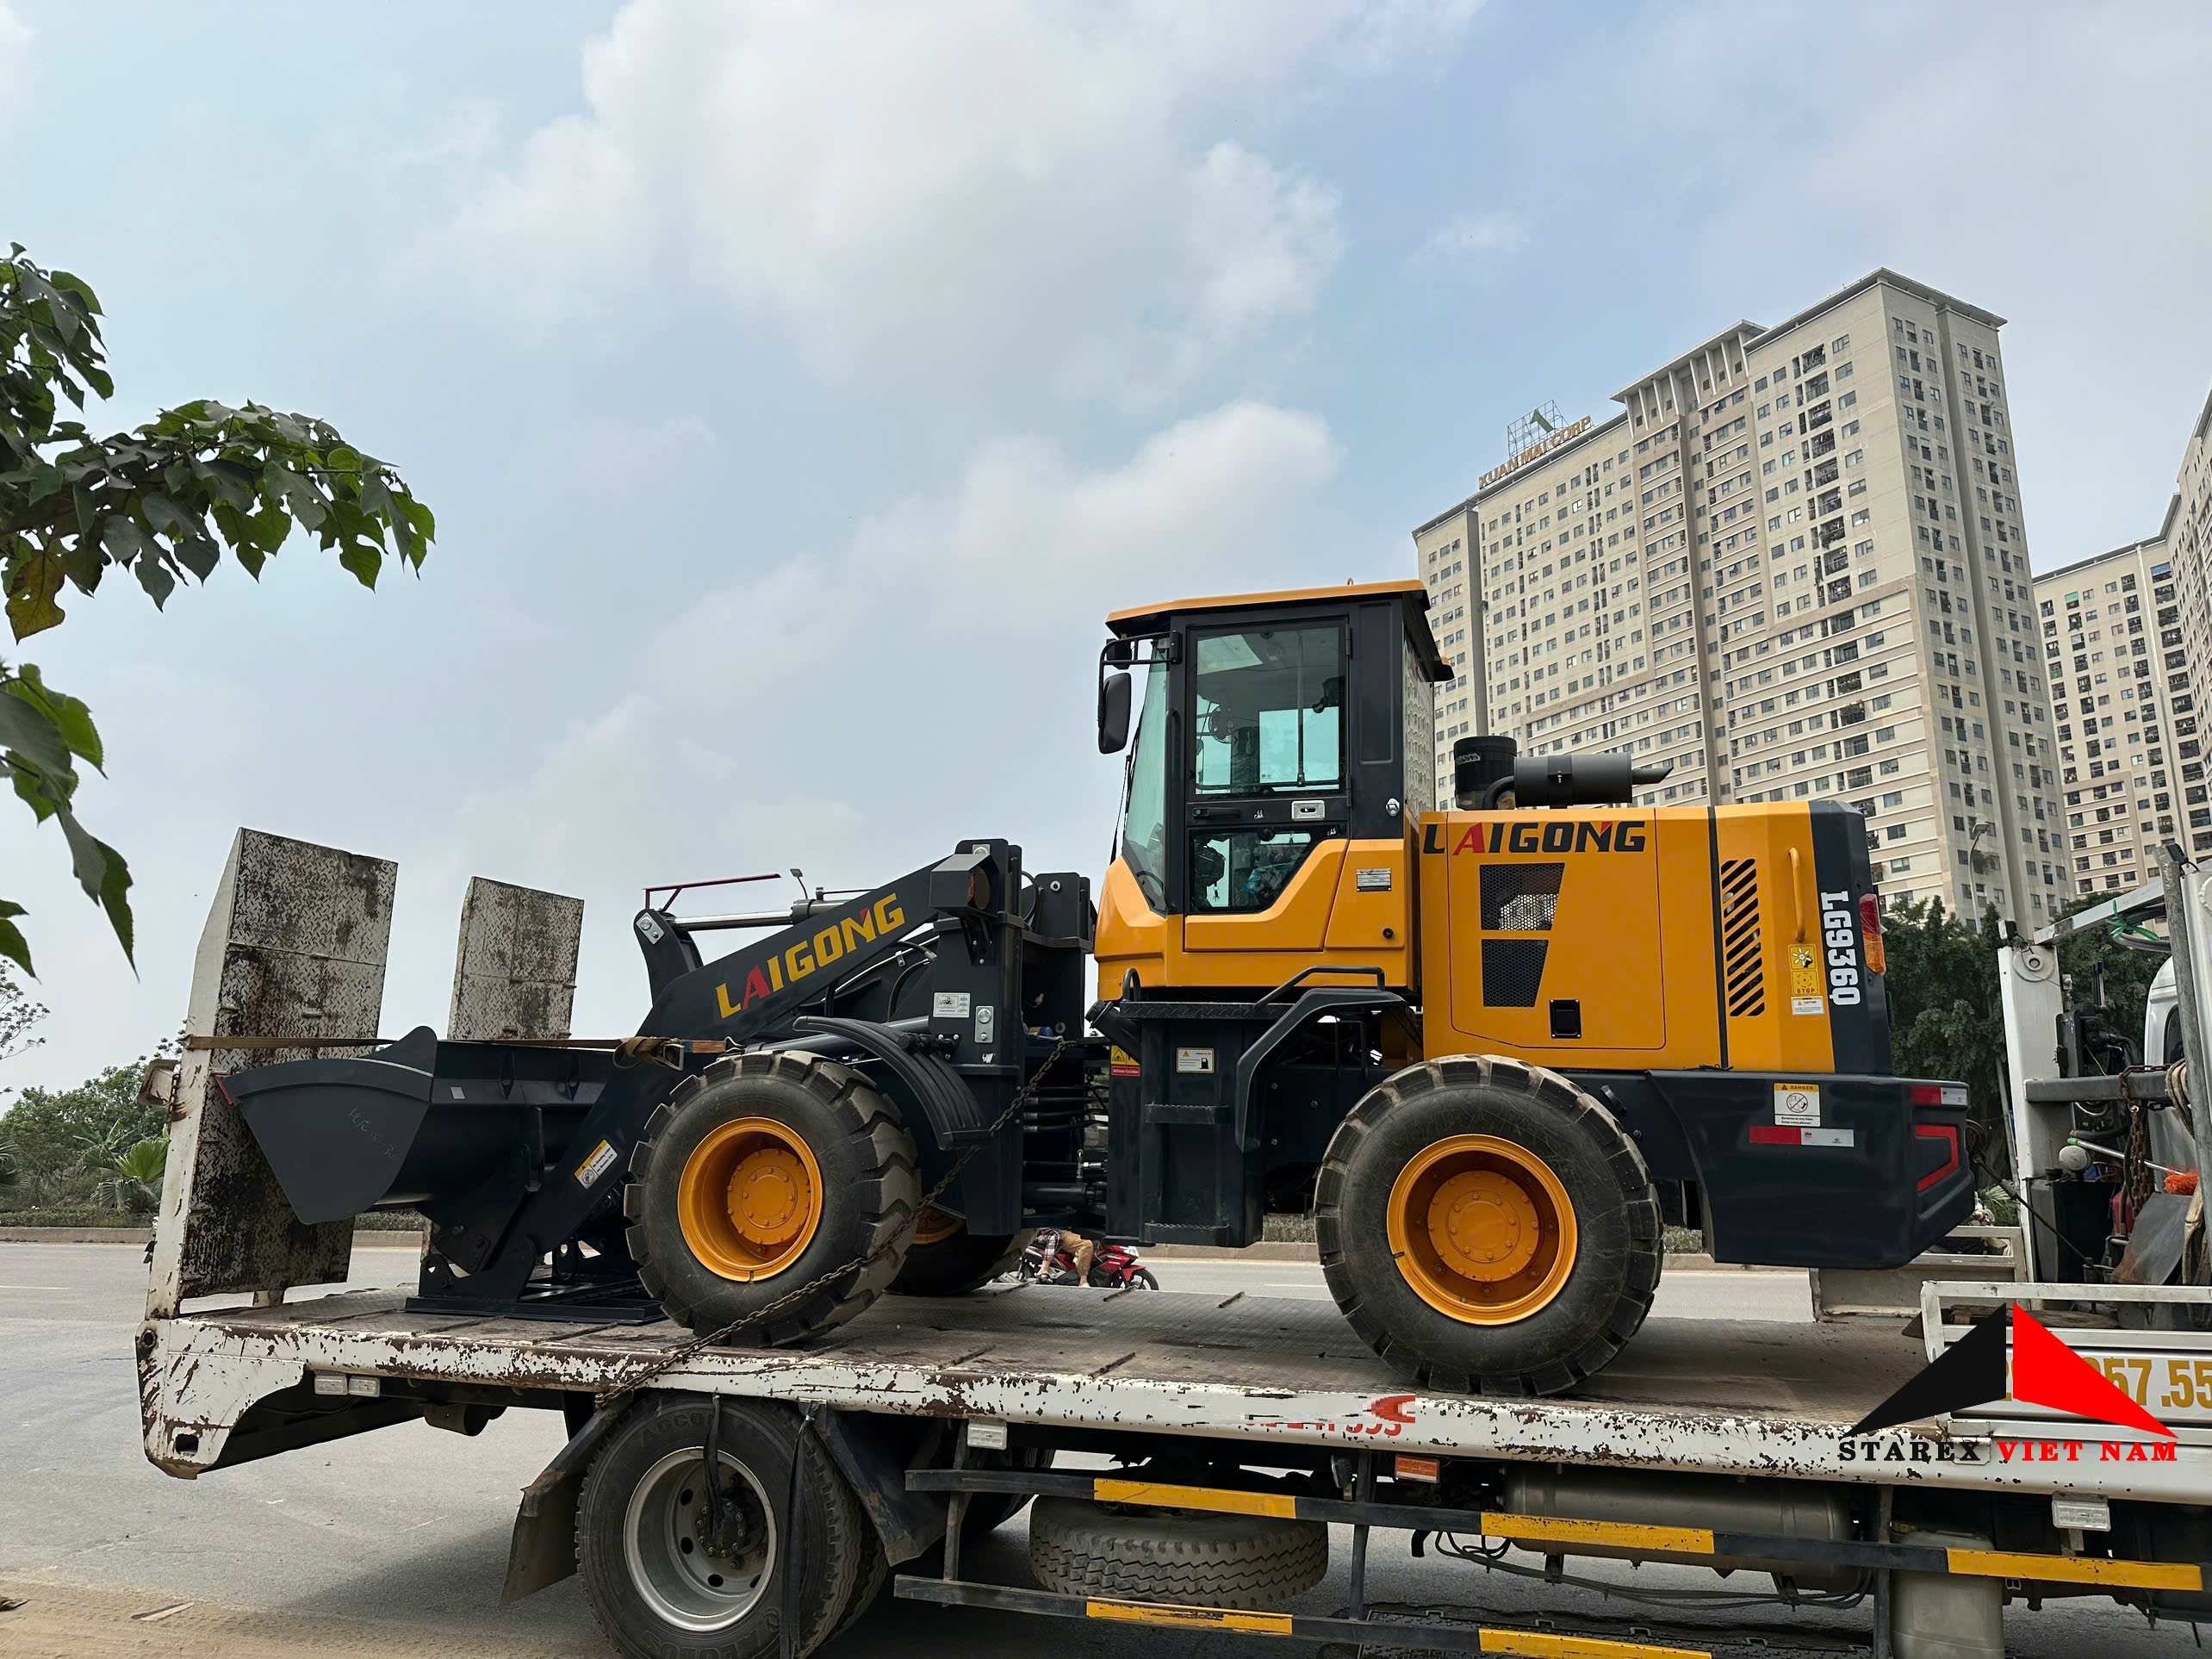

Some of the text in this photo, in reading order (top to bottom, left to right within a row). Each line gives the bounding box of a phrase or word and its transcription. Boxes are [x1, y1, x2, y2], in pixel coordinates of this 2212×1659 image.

[1479, 415, 1591, 489] XUAN MAI CORP
[1423, 821, 1646, 856] LAIGONG
[716, 892, 905, 1019] LAIGONG
